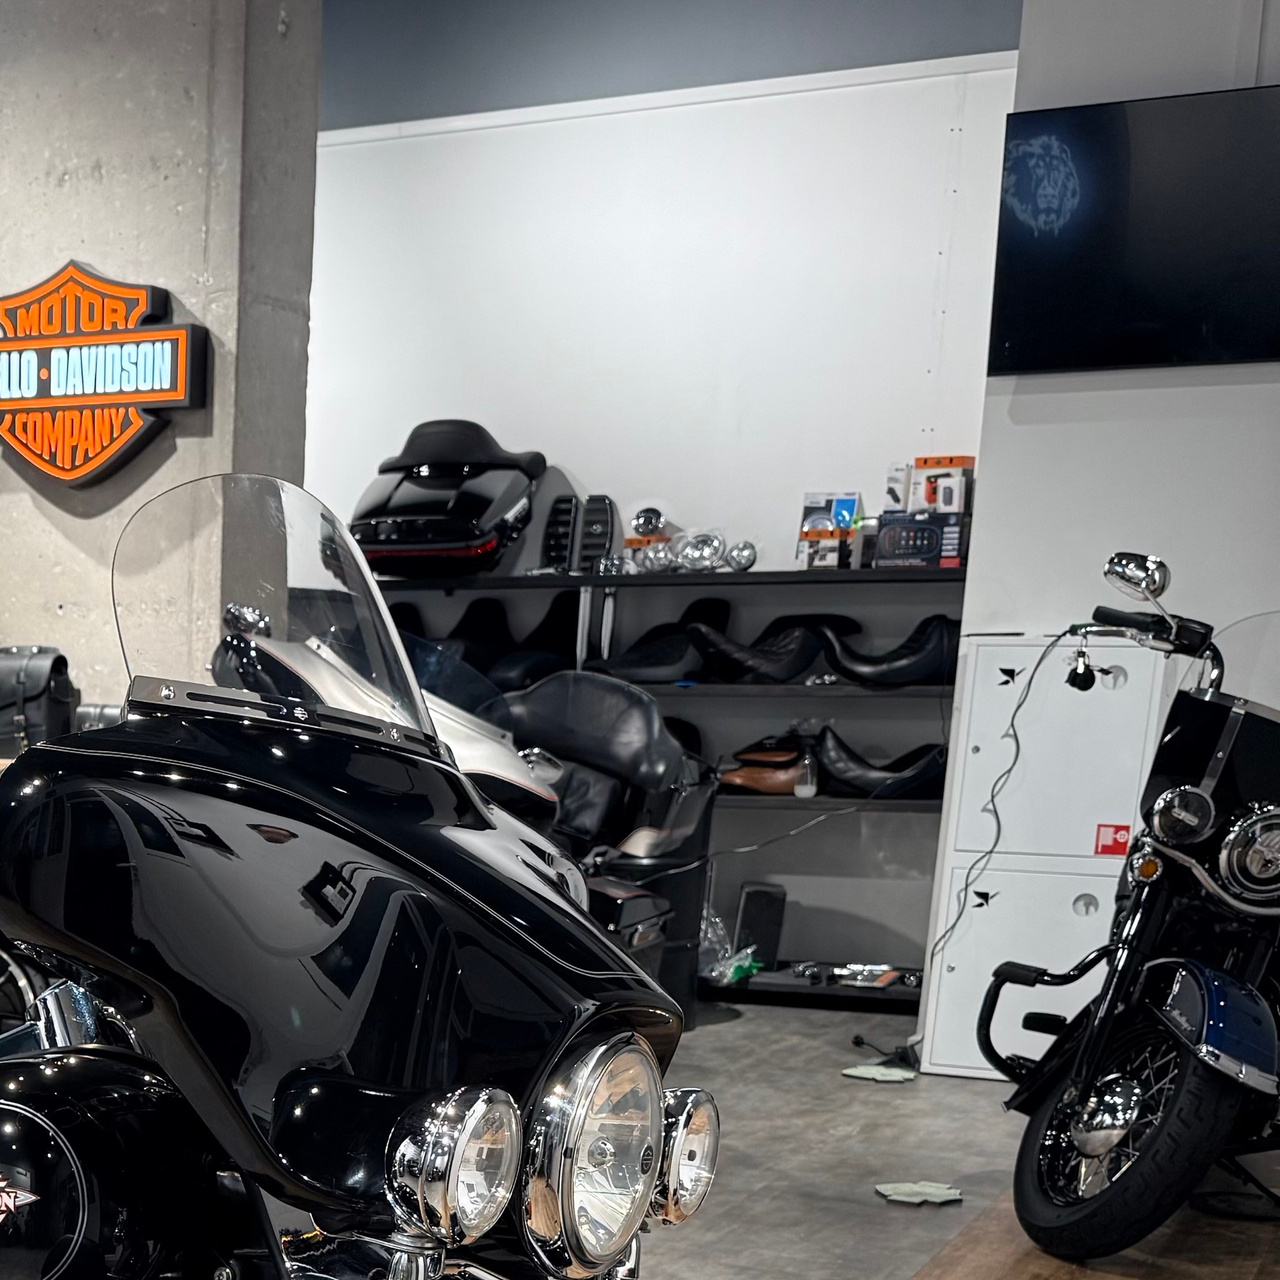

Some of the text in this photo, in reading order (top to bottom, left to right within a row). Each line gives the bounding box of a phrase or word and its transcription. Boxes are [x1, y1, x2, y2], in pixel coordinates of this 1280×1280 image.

[16, 281, 128, 337] MOTOR
[50, 340, 171, 396] DAVIDSON
[15, 406, 126, 469] COMPANY
